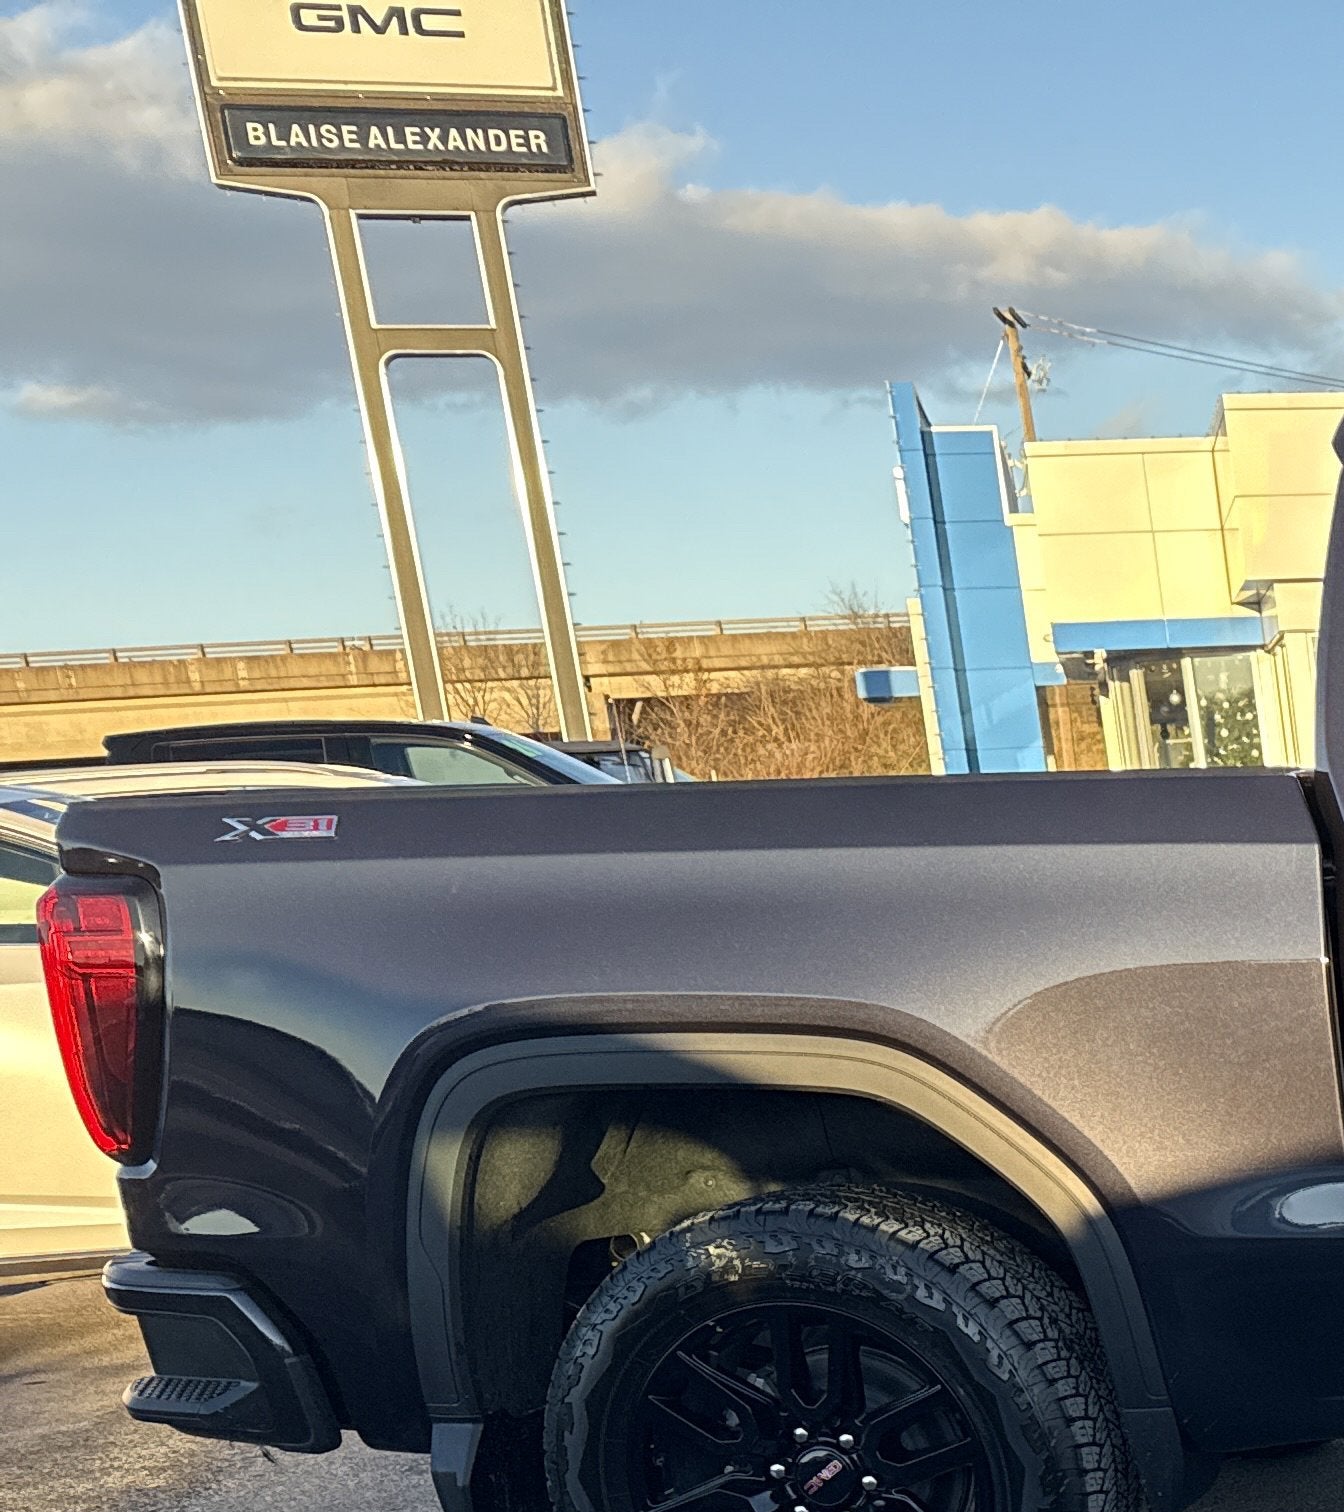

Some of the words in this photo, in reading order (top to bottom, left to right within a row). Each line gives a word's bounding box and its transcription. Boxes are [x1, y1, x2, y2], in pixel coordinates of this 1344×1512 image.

[289, 2, 466, 39] GMC
[244, 121, 359, 150] BLAISE
[366, 125, 549, 154] ALEXANDER
[803, 1459, 843, 1495] GMC
